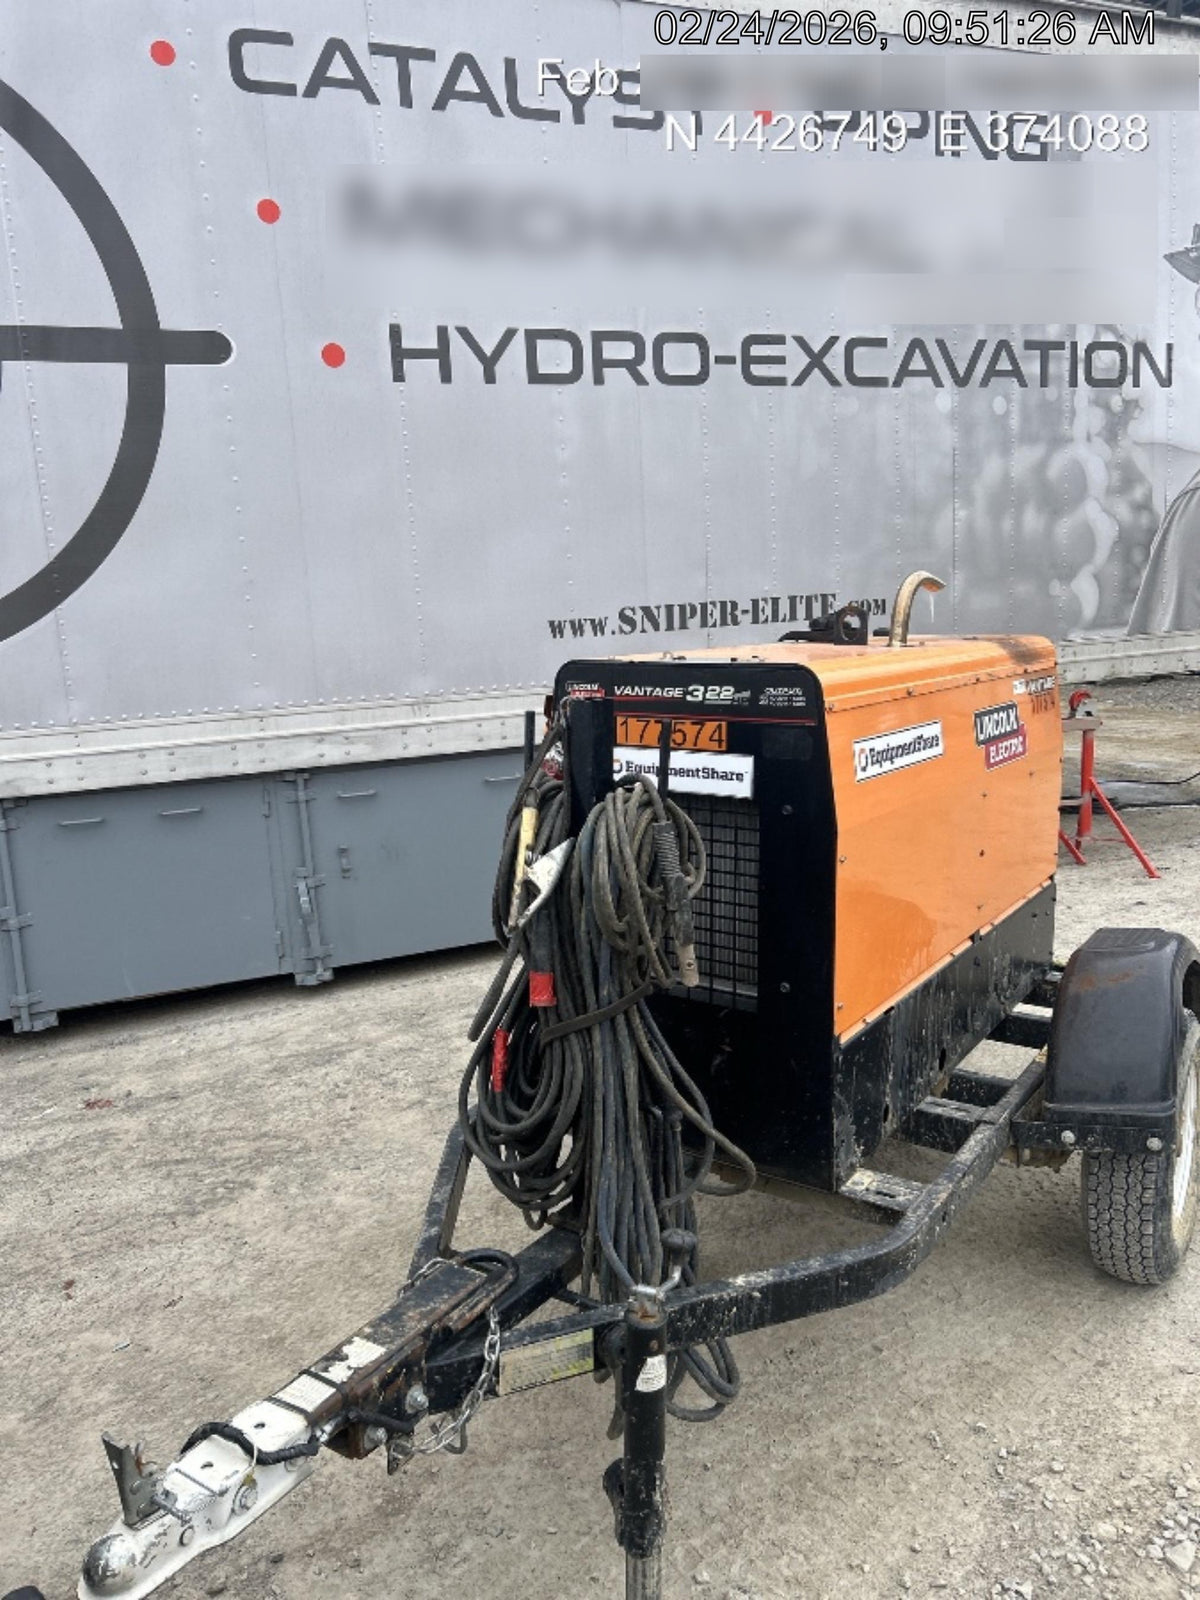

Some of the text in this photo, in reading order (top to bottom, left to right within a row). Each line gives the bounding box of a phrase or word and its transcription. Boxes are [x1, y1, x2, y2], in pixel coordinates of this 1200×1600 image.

[389, 323, 1174, 388] HYDRO-EXCAVATION
[613, 685, 684, 698] VANTAGE
[685, 684, 735, 702] 322
